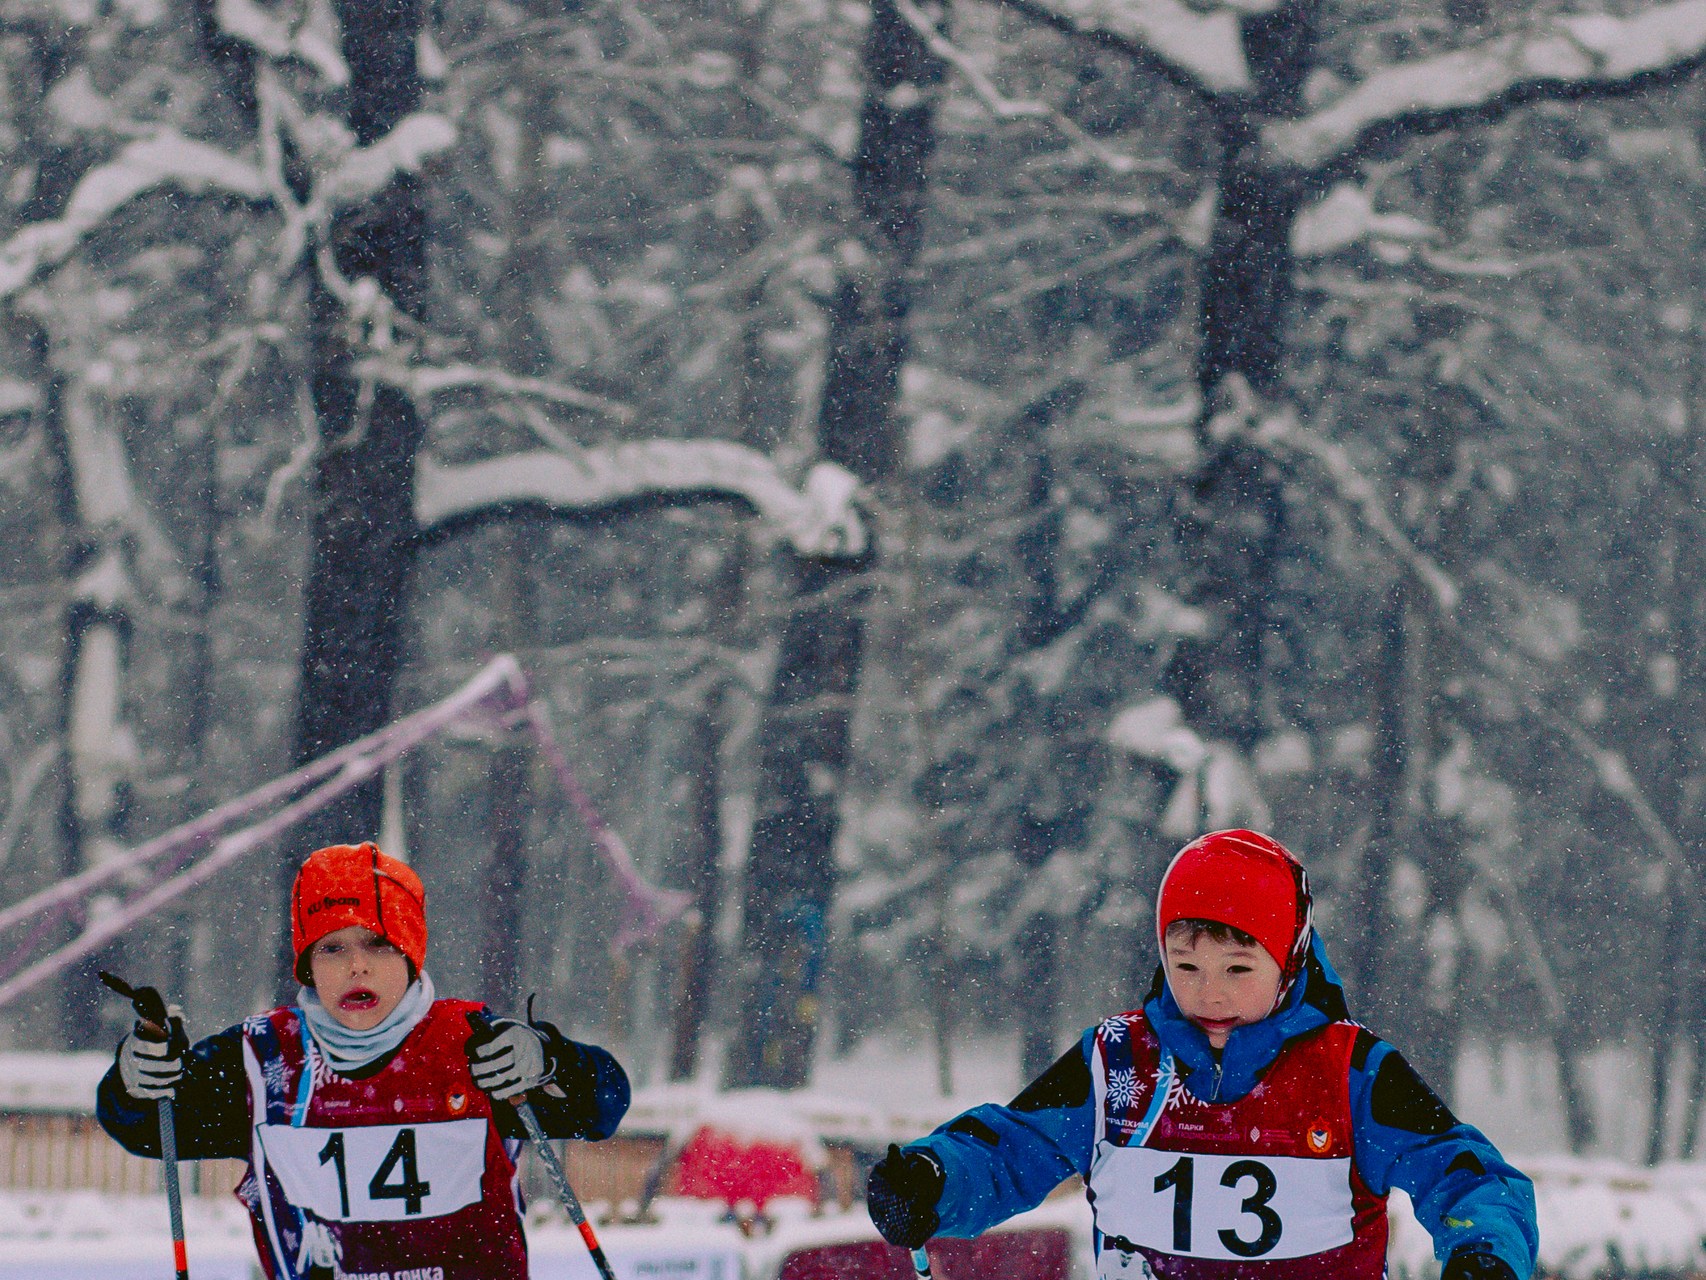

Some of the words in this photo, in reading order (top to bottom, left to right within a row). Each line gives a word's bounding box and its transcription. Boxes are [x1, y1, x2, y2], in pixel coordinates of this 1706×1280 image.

[1178, 1122, 1204, 1131] ПАРКИ
[318, 1128, 431, 1218] 14
[1154, 1156, 1283, 1258] 13
